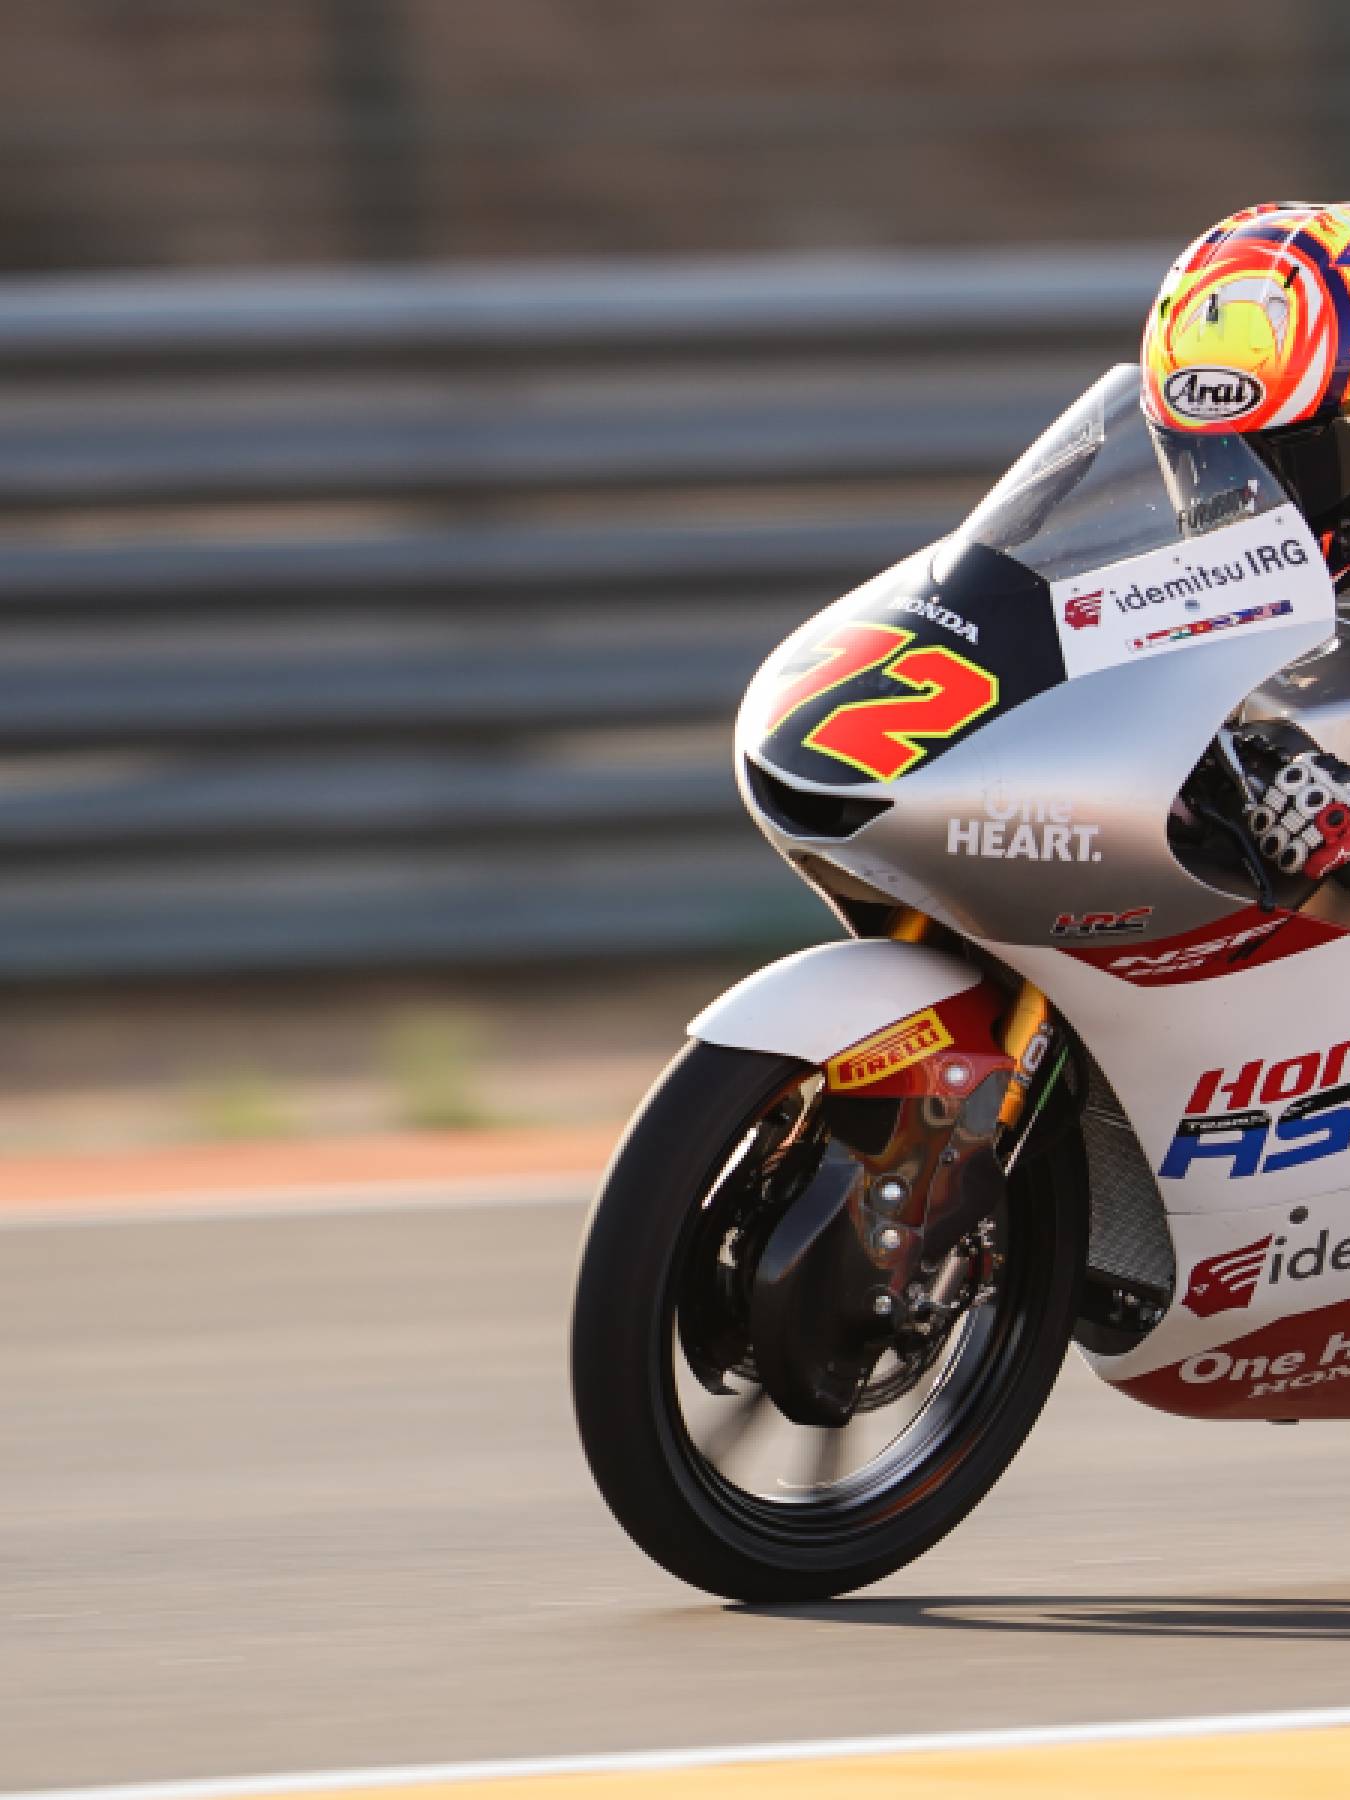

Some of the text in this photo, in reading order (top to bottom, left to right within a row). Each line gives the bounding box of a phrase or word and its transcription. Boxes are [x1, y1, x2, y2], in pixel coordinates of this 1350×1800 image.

[1167, 374, 1248, 404] Arai
[1108, 538, 1309, 613] idemitsu IRG
[766, 621, 1000, 784] 72
[982, 782, 1073, 824] One
[947, 818, 1103, 863] HEART.
[1050, 906, 1154, 936] HRC
[838, 1019, 939, 1083] PIRELLI
[1179, 1348, 1306, 1384] One
